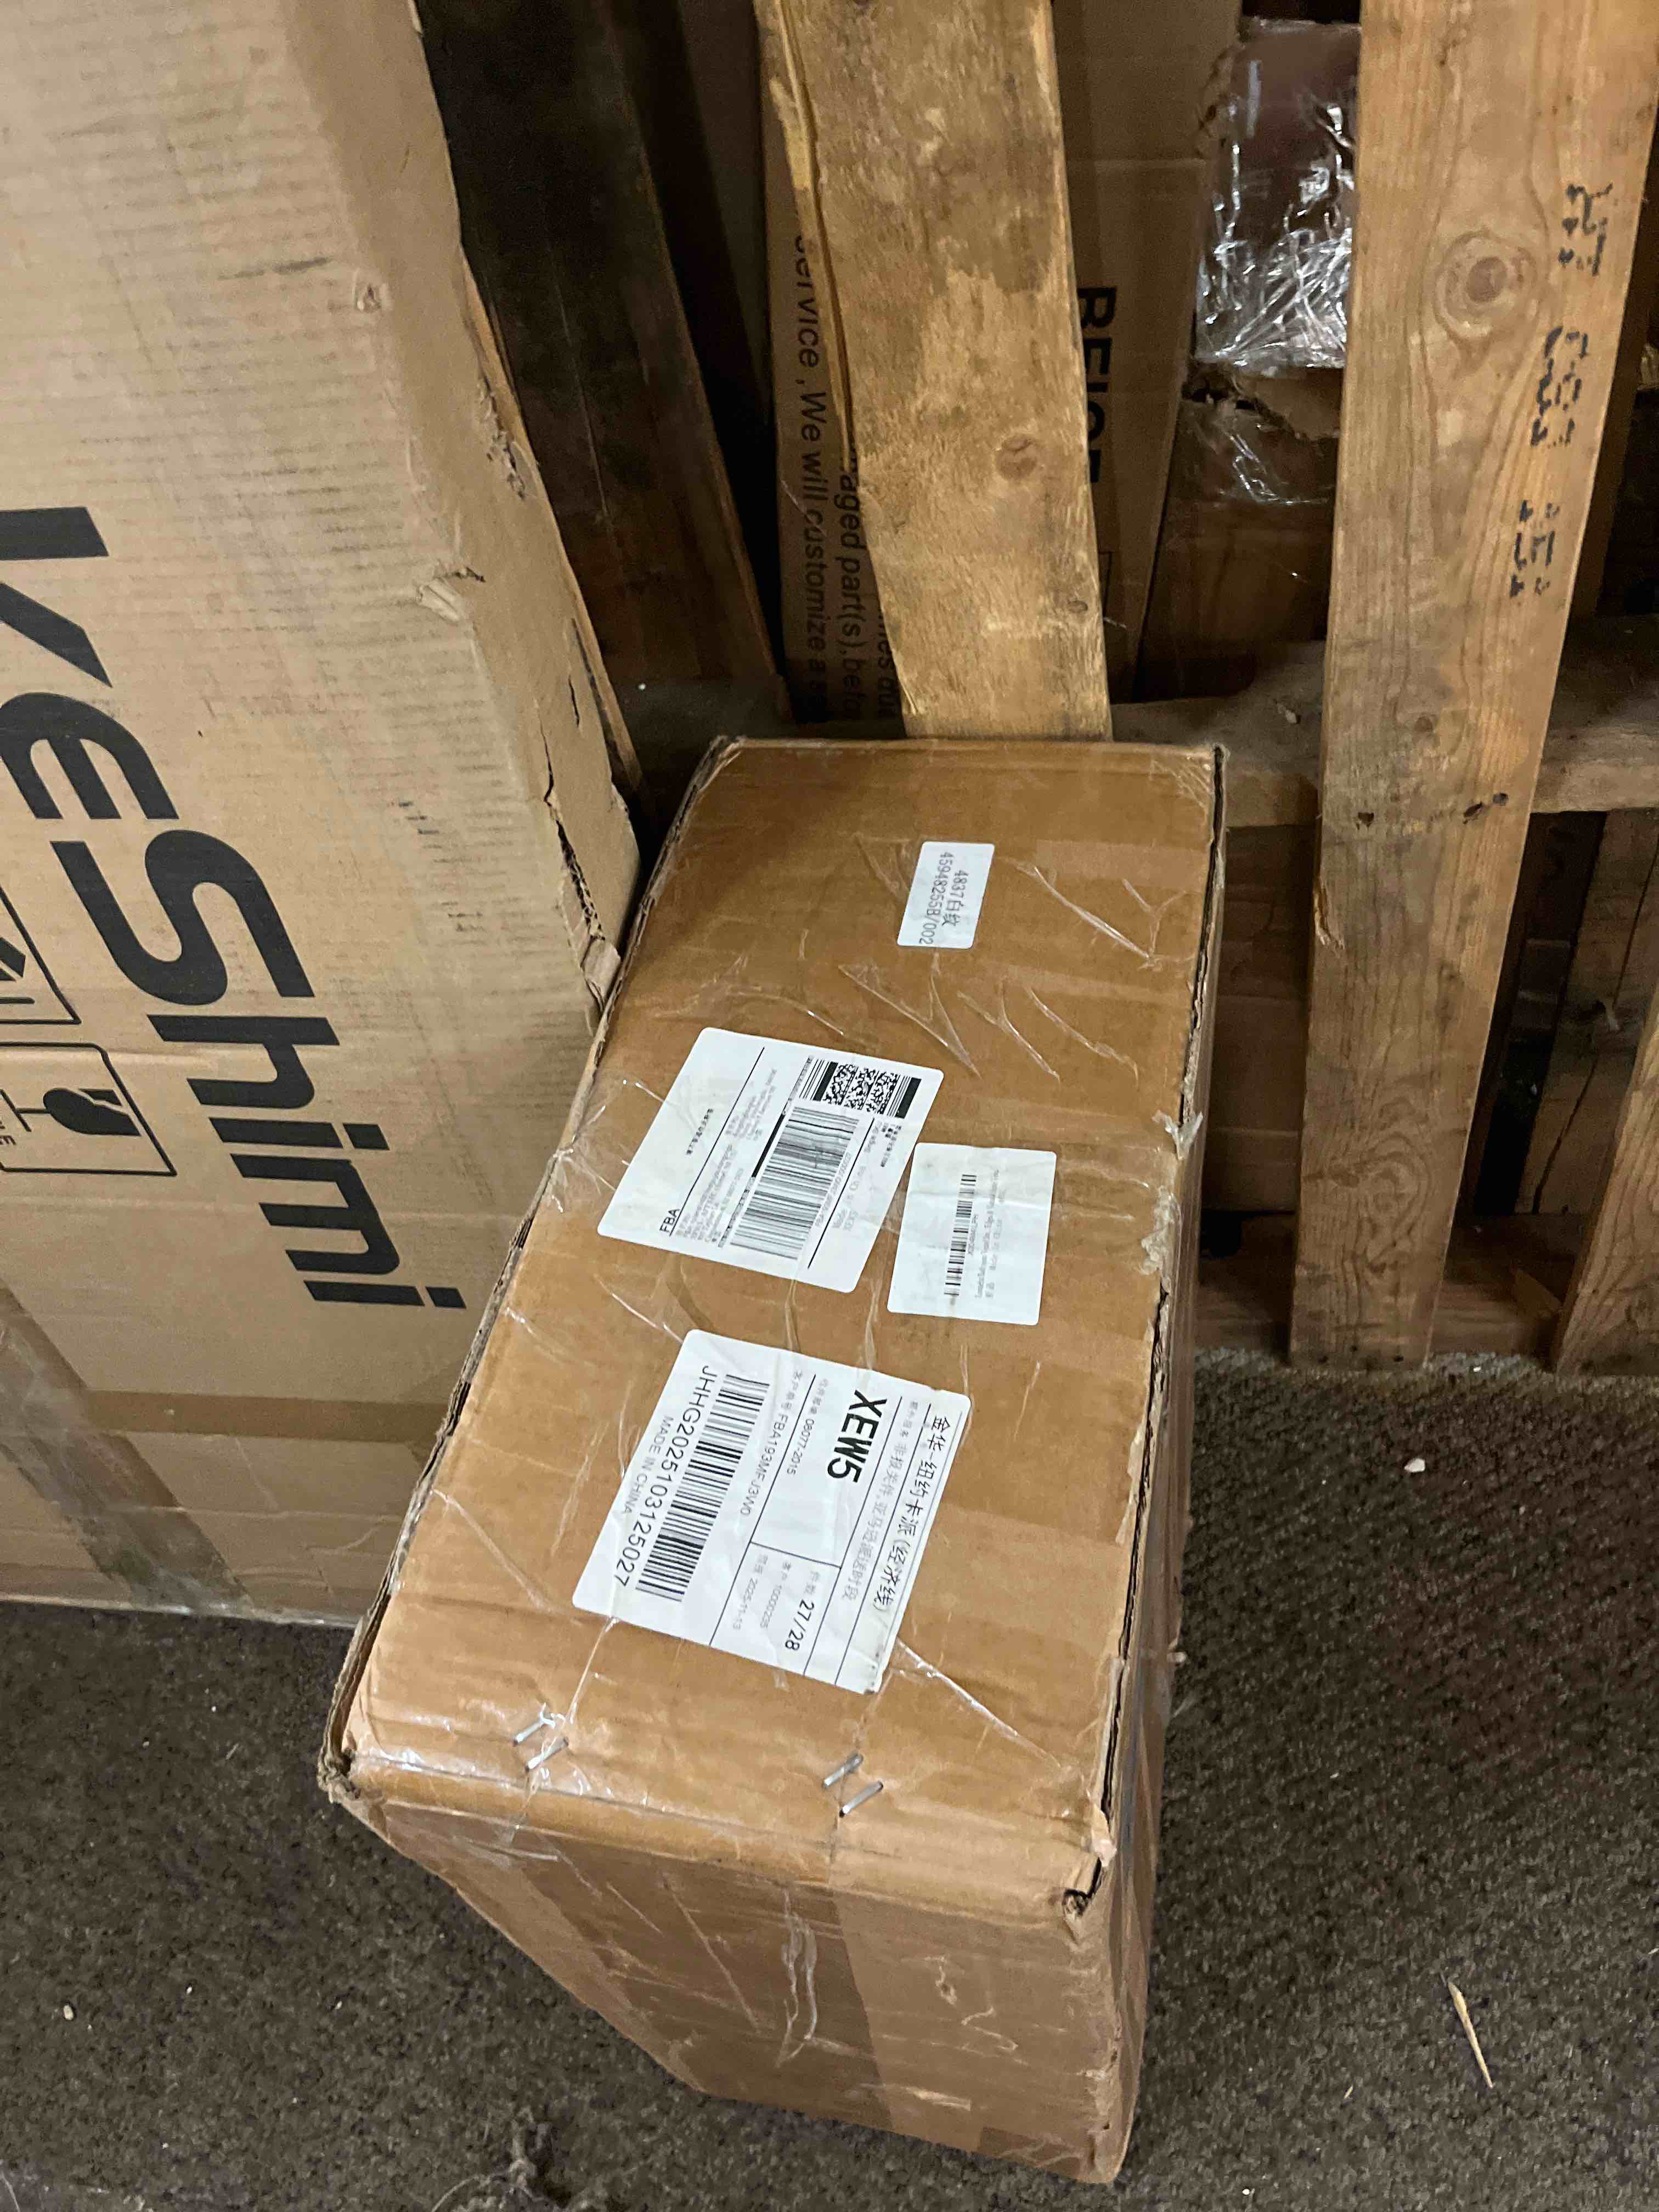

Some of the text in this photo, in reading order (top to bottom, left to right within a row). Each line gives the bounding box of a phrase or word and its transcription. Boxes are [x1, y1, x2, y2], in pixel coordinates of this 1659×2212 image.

[802, 452, 829, 500] will
[804, 509, 831, 651] customize
[658, 1208, 680, 1233] FBA
[616, 1365, 716, 1585] JHHG2025103125027
[622, 1415, 674, 1514] MADE IN CHINA
[740, 1414, 788, 1515] FBA193MFJ3W0
[786, 1418, 815, 1475] 08077-2015
[827, 1390, 887, 1482] XEW5
[873, 1417, 950, 1610] 金华-纽约卡派(经济线)
[784, 1599, 815, 1651] 27/28
